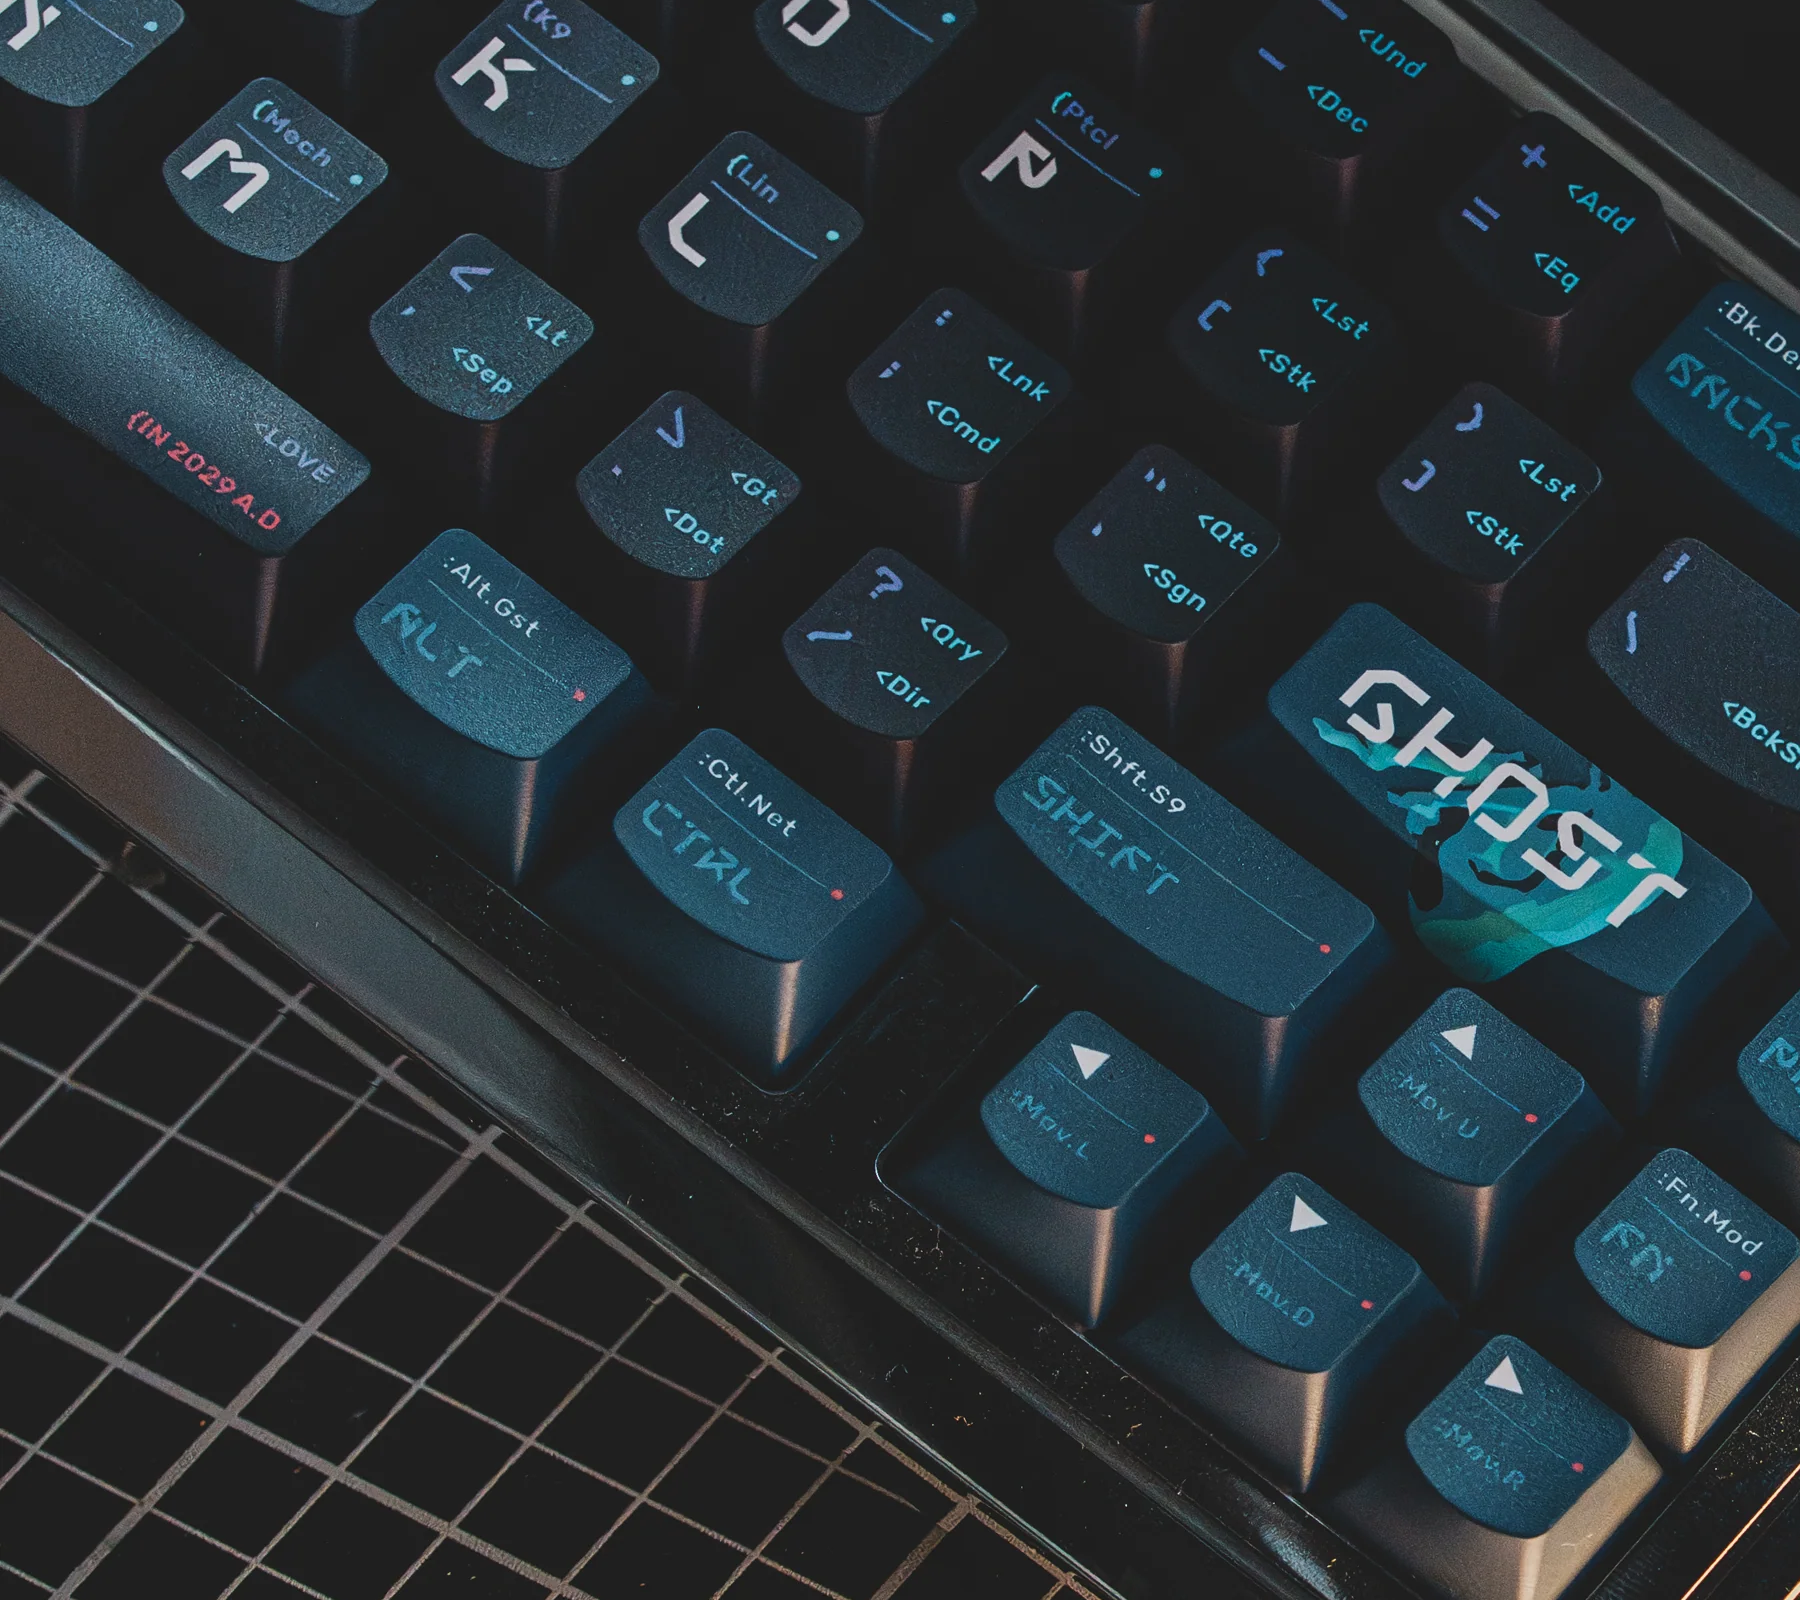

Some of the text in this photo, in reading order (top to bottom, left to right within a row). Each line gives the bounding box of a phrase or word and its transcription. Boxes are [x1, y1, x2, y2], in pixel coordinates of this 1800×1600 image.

[450, 35, 537, 112] K
[180, 138, 271, 214] M
[667, 192, 710, 269] L
[167, 441, 236, 494] 2029
[1338, 668, 1689, 929] GHOST
